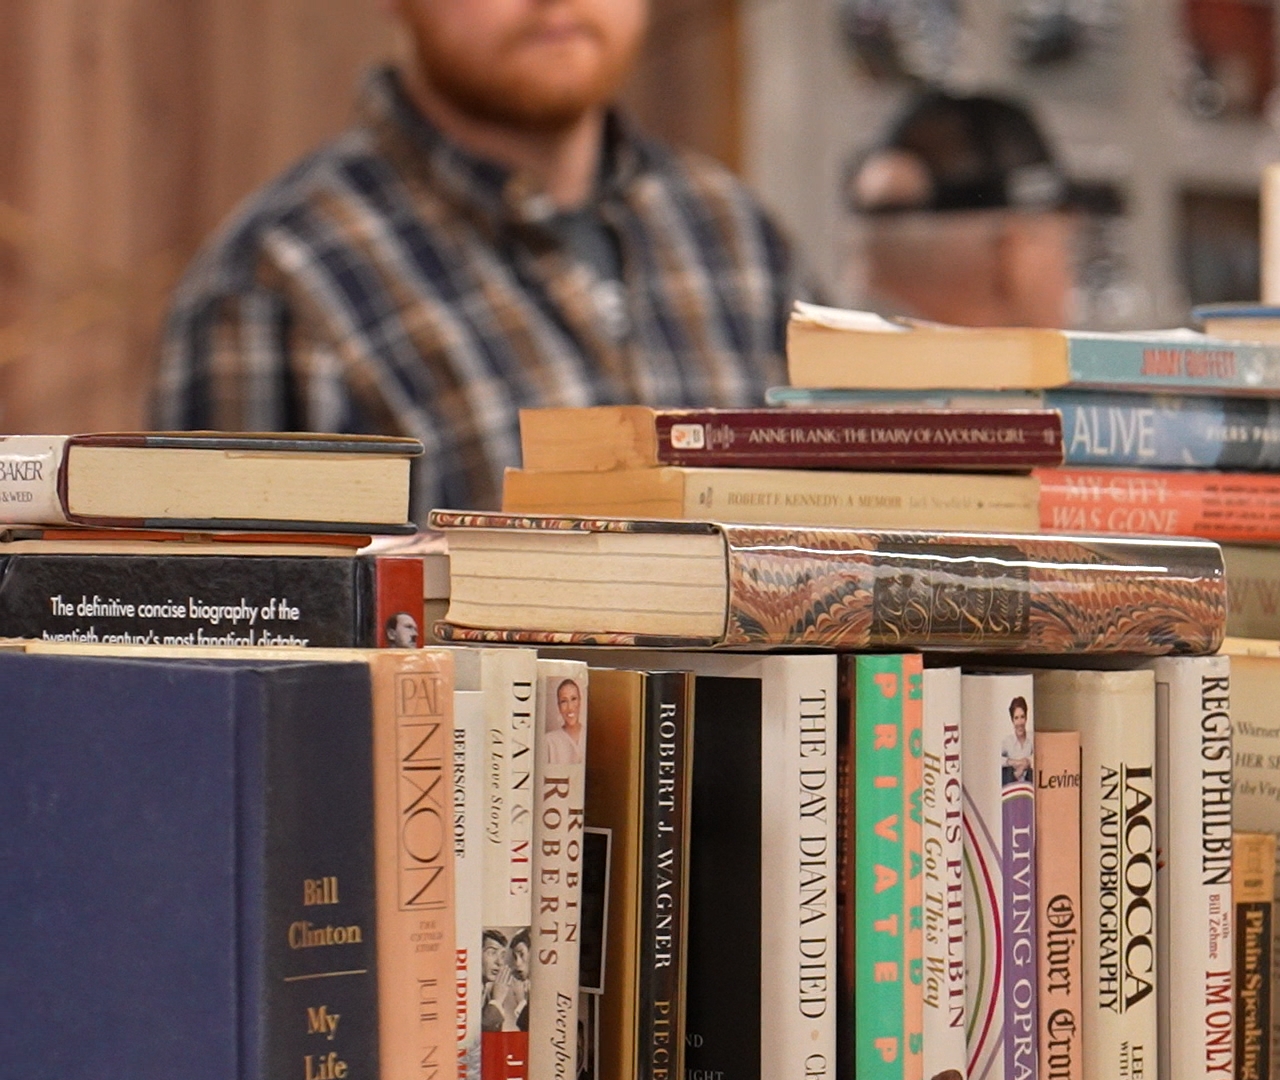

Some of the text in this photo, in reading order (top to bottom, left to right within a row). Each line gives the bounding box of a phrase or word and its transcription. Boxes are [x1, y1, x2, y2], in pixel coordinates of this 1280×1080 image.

[1070, 407, 1155, 456] ALIVE
[1051, 507, 1178, 534] WAS GONE
[1065, 474, 1167, 503] MY CITY
[51, 596, 300, 625] The definitive concise biography of the
[402, 679, 441, 716] PAT
[401, 723, 446, 906] NIXON
[509, 681, 532, 896] DEAN & ME
[874, 673, 898, 983] PRIVATE
[1038, 769, 1081, 790] Levine
[1202, 676, 1231, 886] REGIS PHILBIN
[539, 776, 570, 966] ROBERTS
[564, 807, 584, 942] ROBIN
[655, 703, 676, 970] ROBERT J. WAGNER
[800, 690, 828, 1019] THE DAY DIANA DIED
[943, 722, 966, 1028] REGIS PHILBIN
[288, 922, 362, 951] Clinton
[303, 877, 339, 906] Bill
[1011, 824, 1033, 966] LIVING
[1099, 767, 1119, 1014] AN AUTOBIOGRAPHY
[1124, 763, 1155, 1013] IACOCCA
[1208, 894, 1220, 960] Bill Zehme
[308, 1006, 340, 1042] My
[1206, 970, 1231, 1006] I'M
[1205, 1010, 1232, 1074] ONLY
